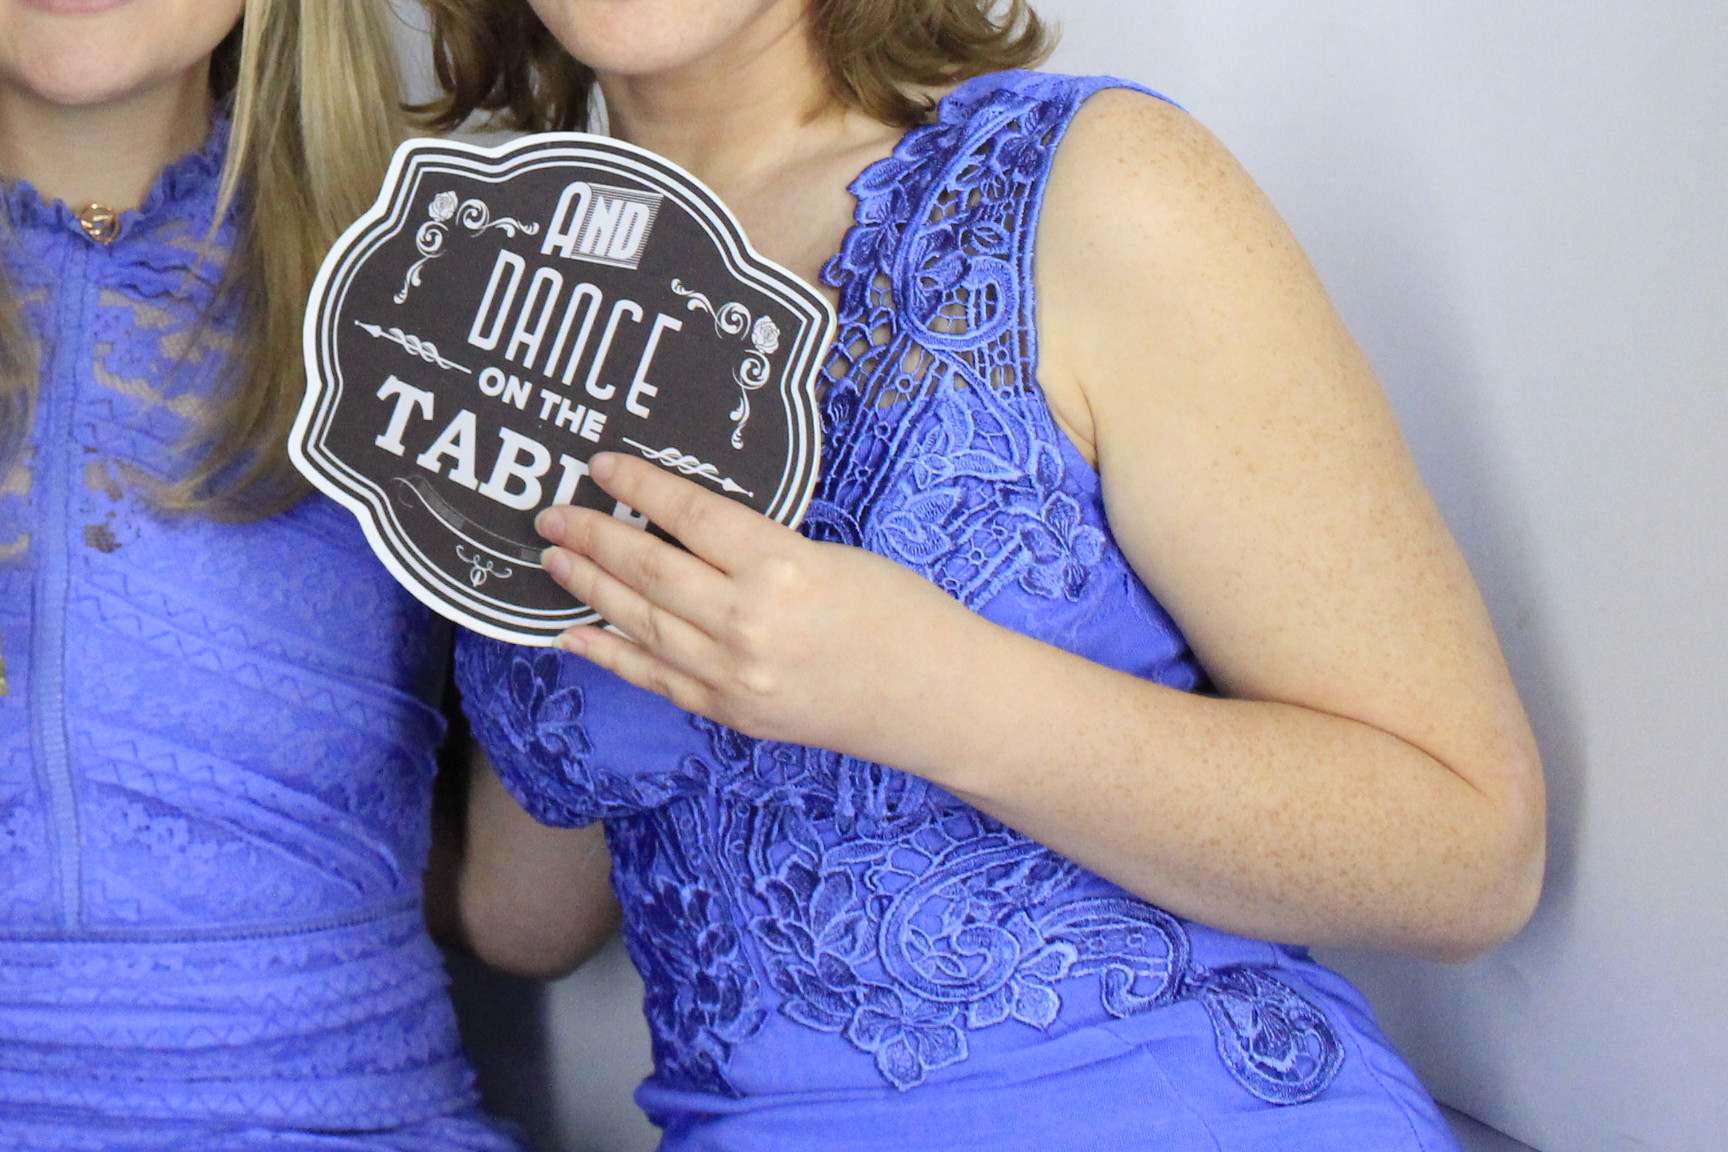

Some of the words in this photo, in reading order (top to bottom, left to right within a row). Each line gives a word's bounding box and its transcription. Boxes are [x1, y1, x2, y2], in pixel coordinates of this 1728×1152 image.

[541, 181, 656, 263] AND
[467, 249, 683, 419] DANCE
[374, 375, 649, 530] TABL
[478, 367, 533, 410] ON
[539, 389, 608, 442] THE
